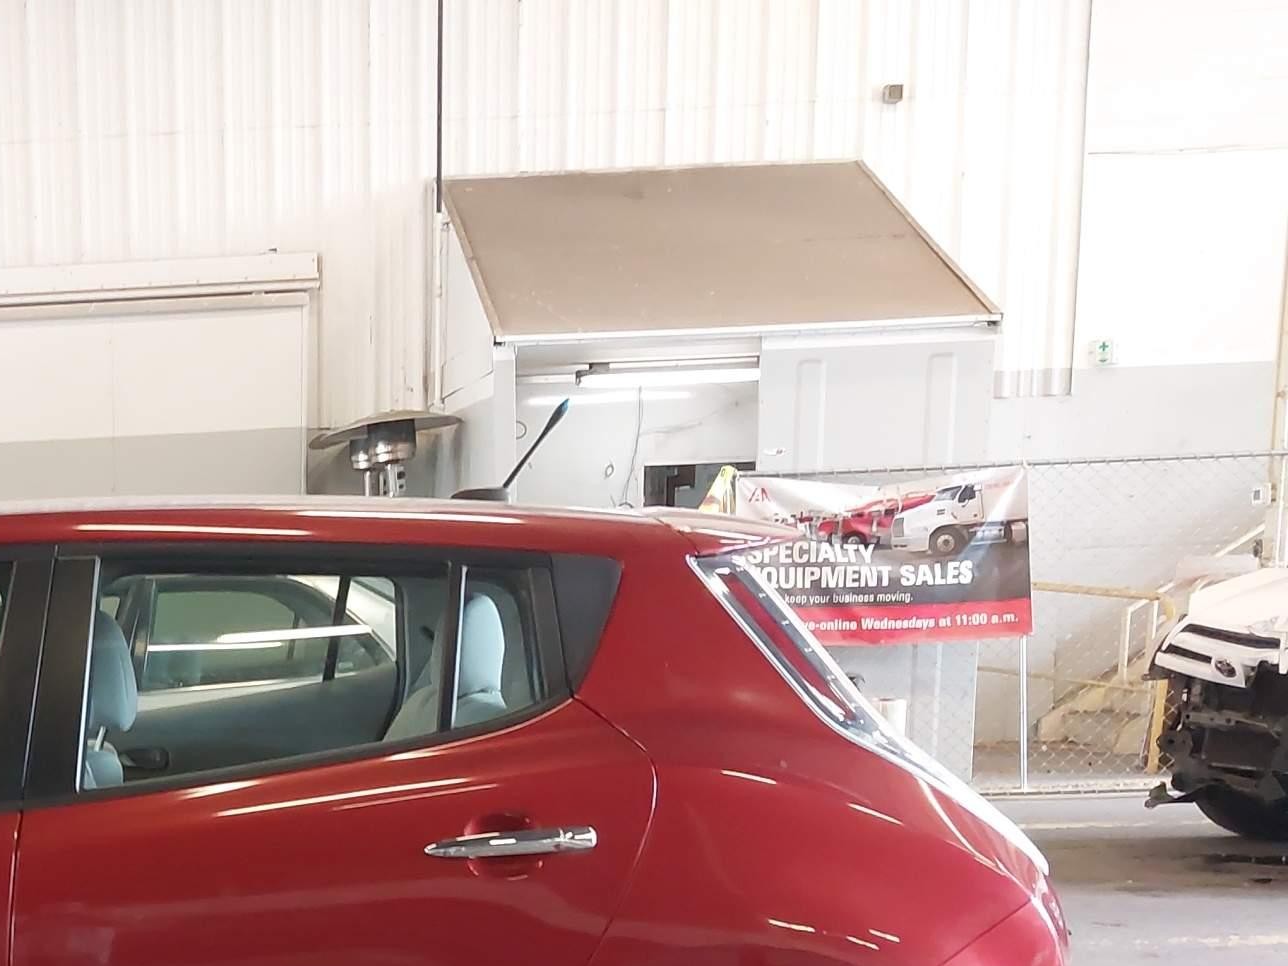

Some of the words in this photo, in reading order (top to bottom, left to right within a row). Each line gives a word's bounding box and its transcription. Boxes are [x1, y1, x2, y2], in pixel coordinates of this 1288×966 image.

[747, 540, 876, 564] SPECIALTY
[757, 564, 892, 589] QUIPMENT
[899, 560, 974, 587] SALES
[784, 593, 808, 605] keep
[808, 594, 831, 605] your
[832, 592, 875, 604] business
[876, 590, 914, 603] moving.
[804, 618, 858, 631] ve-online
[860, 616, 935, 630] Wednesdays
[938, 616, 952, 627] at
[955, 613, 988, 626] 11:00
[991, 613, 1019, 624] a.m.
